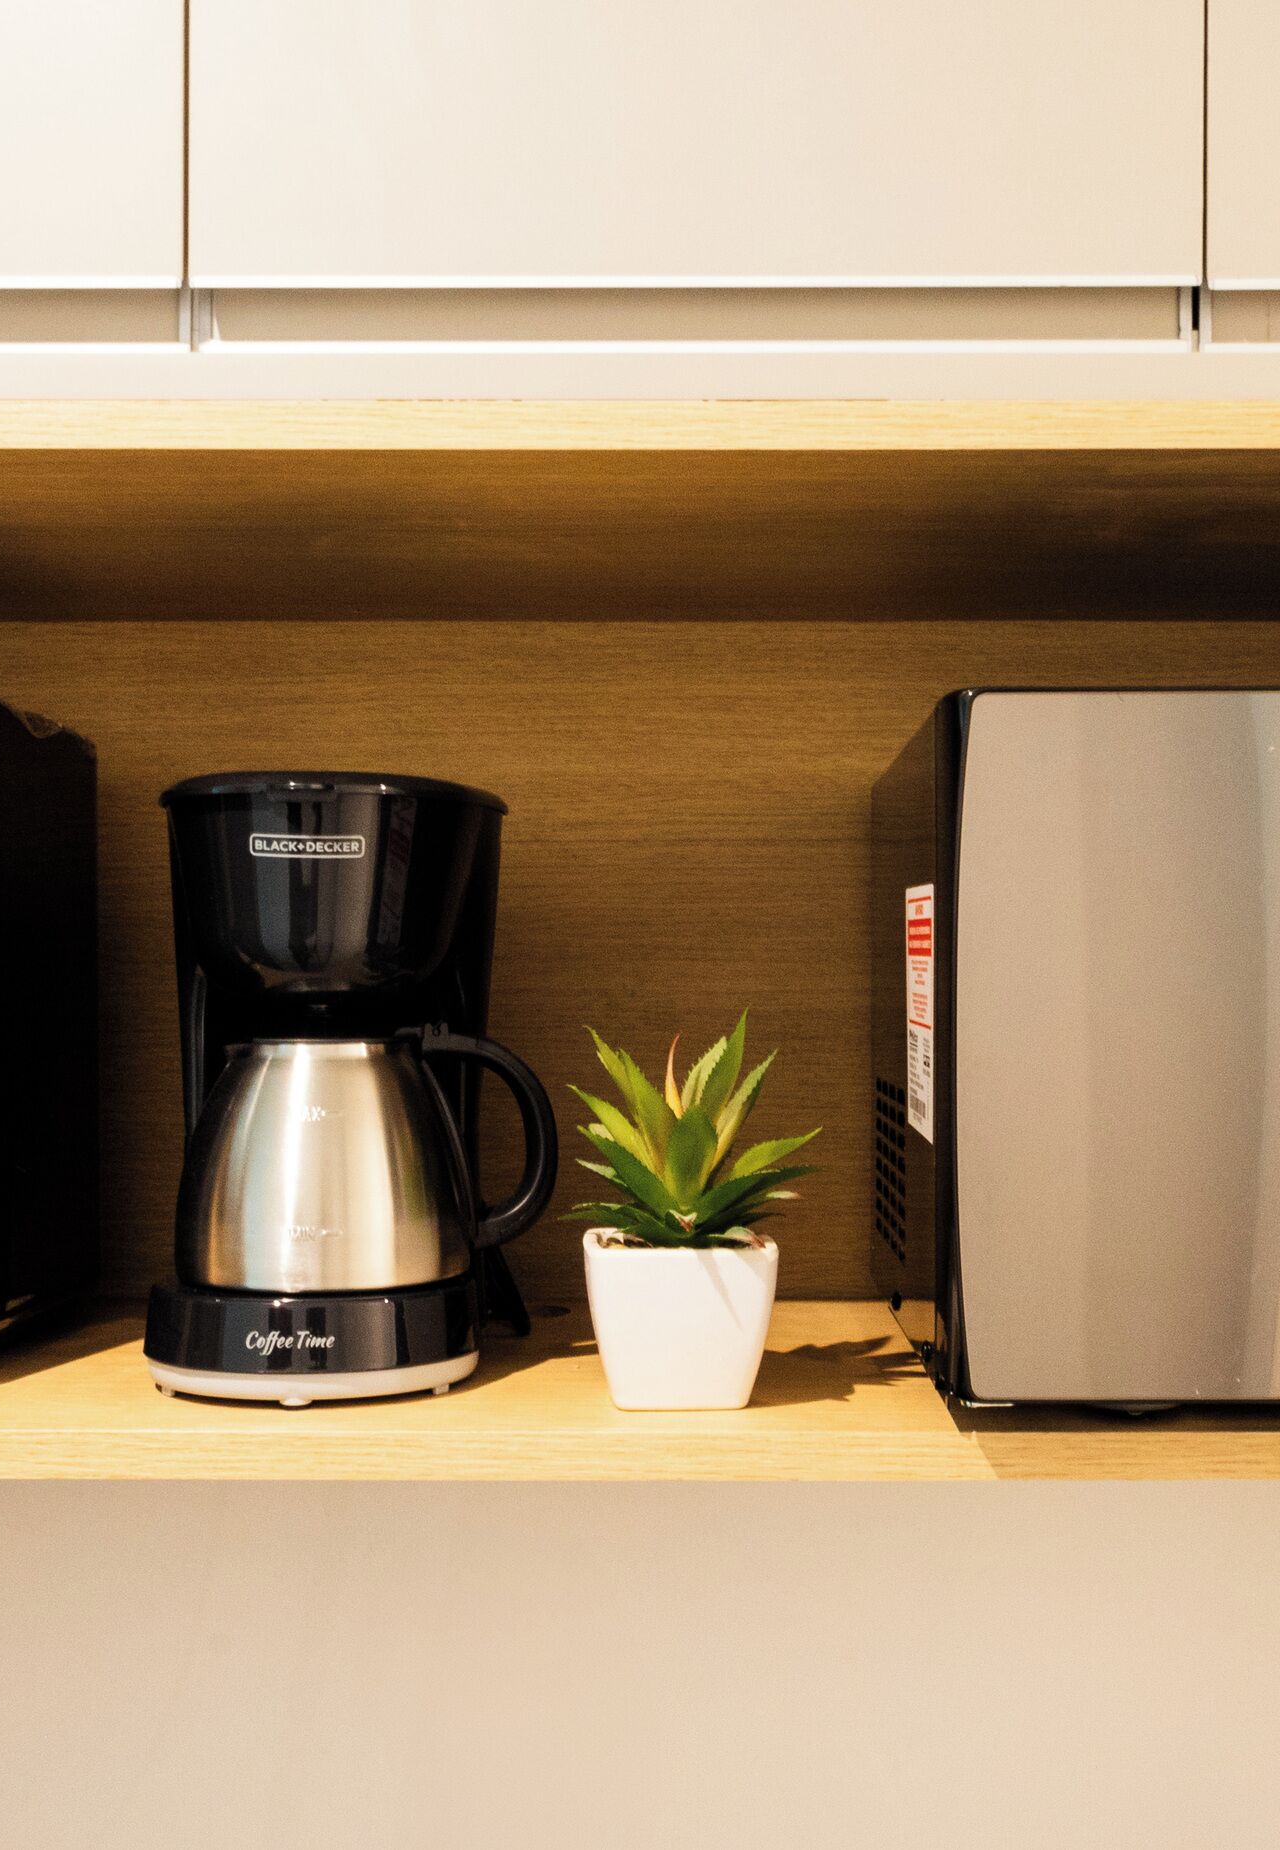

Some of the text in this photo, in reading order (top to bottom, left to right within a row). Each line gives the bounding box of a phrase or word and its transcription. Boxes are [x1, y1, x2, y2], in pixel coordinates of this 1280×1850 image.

[254, 839, 360, 853] BLACK+DECKER
[245, 1330, 336, 1356] Coffee Time
